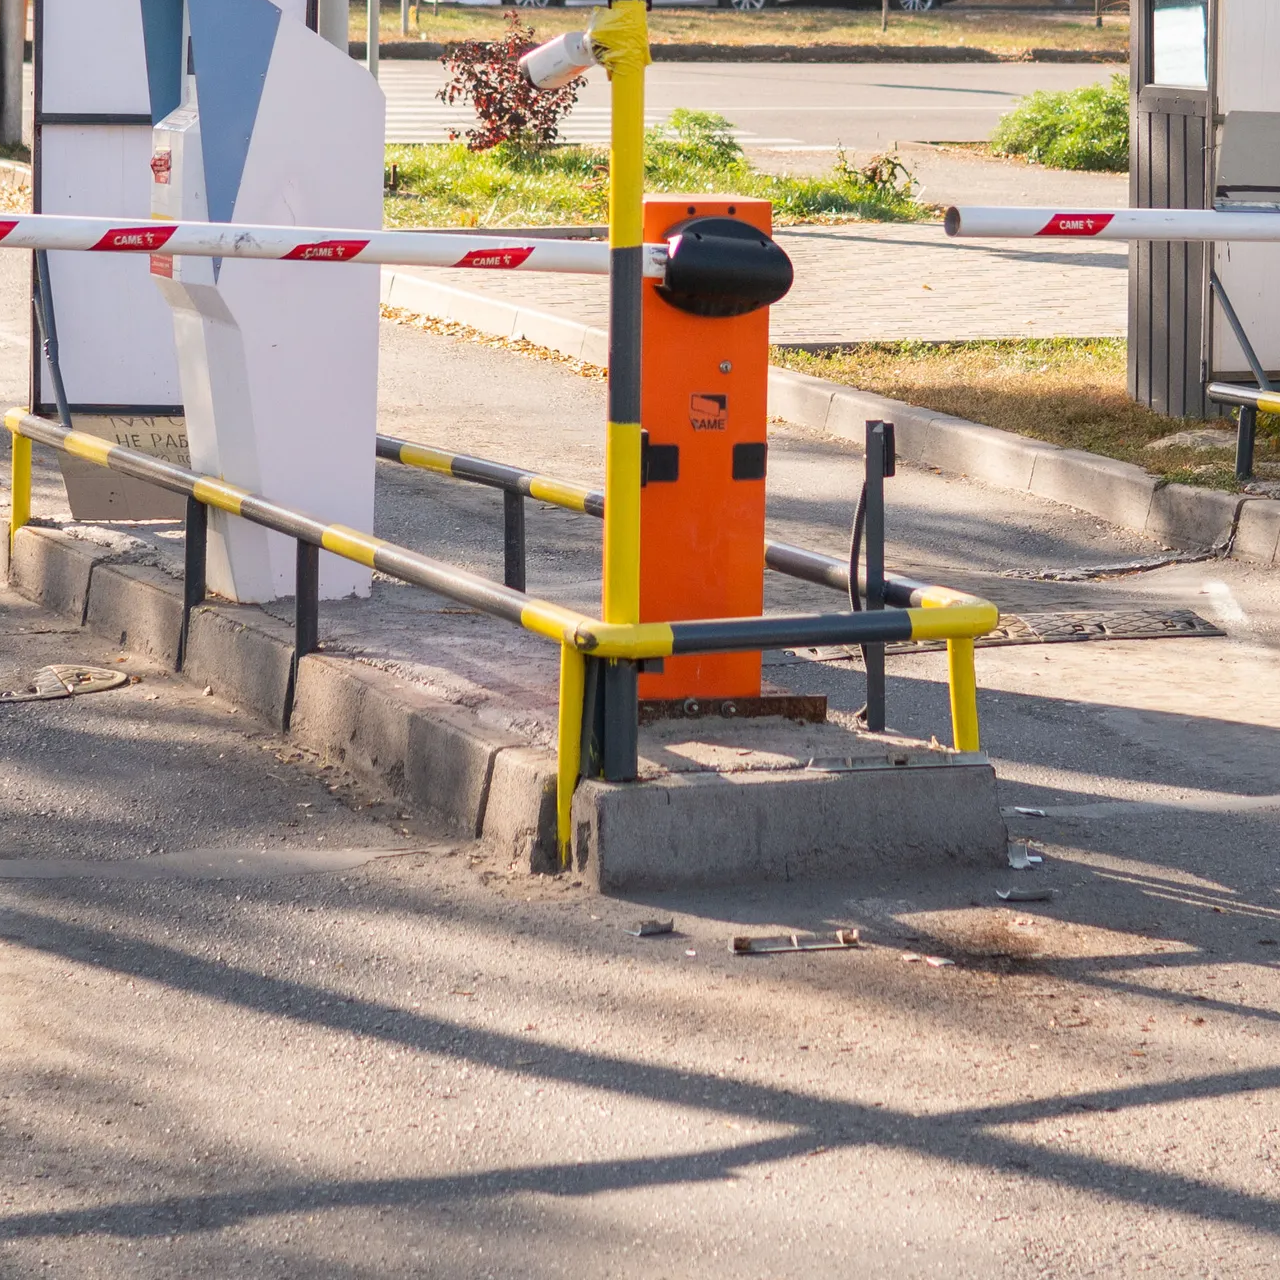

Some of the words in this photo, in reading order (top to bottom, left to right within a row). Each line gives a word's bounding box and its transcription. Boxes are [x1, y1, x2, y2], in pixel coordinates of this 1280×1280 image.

[1060, 221, 1084, 230] CAME
[113, 235, 143, 245] CAME
[305, 247, 333, 257] CAME
[472, 256, 501, 266] CAME
